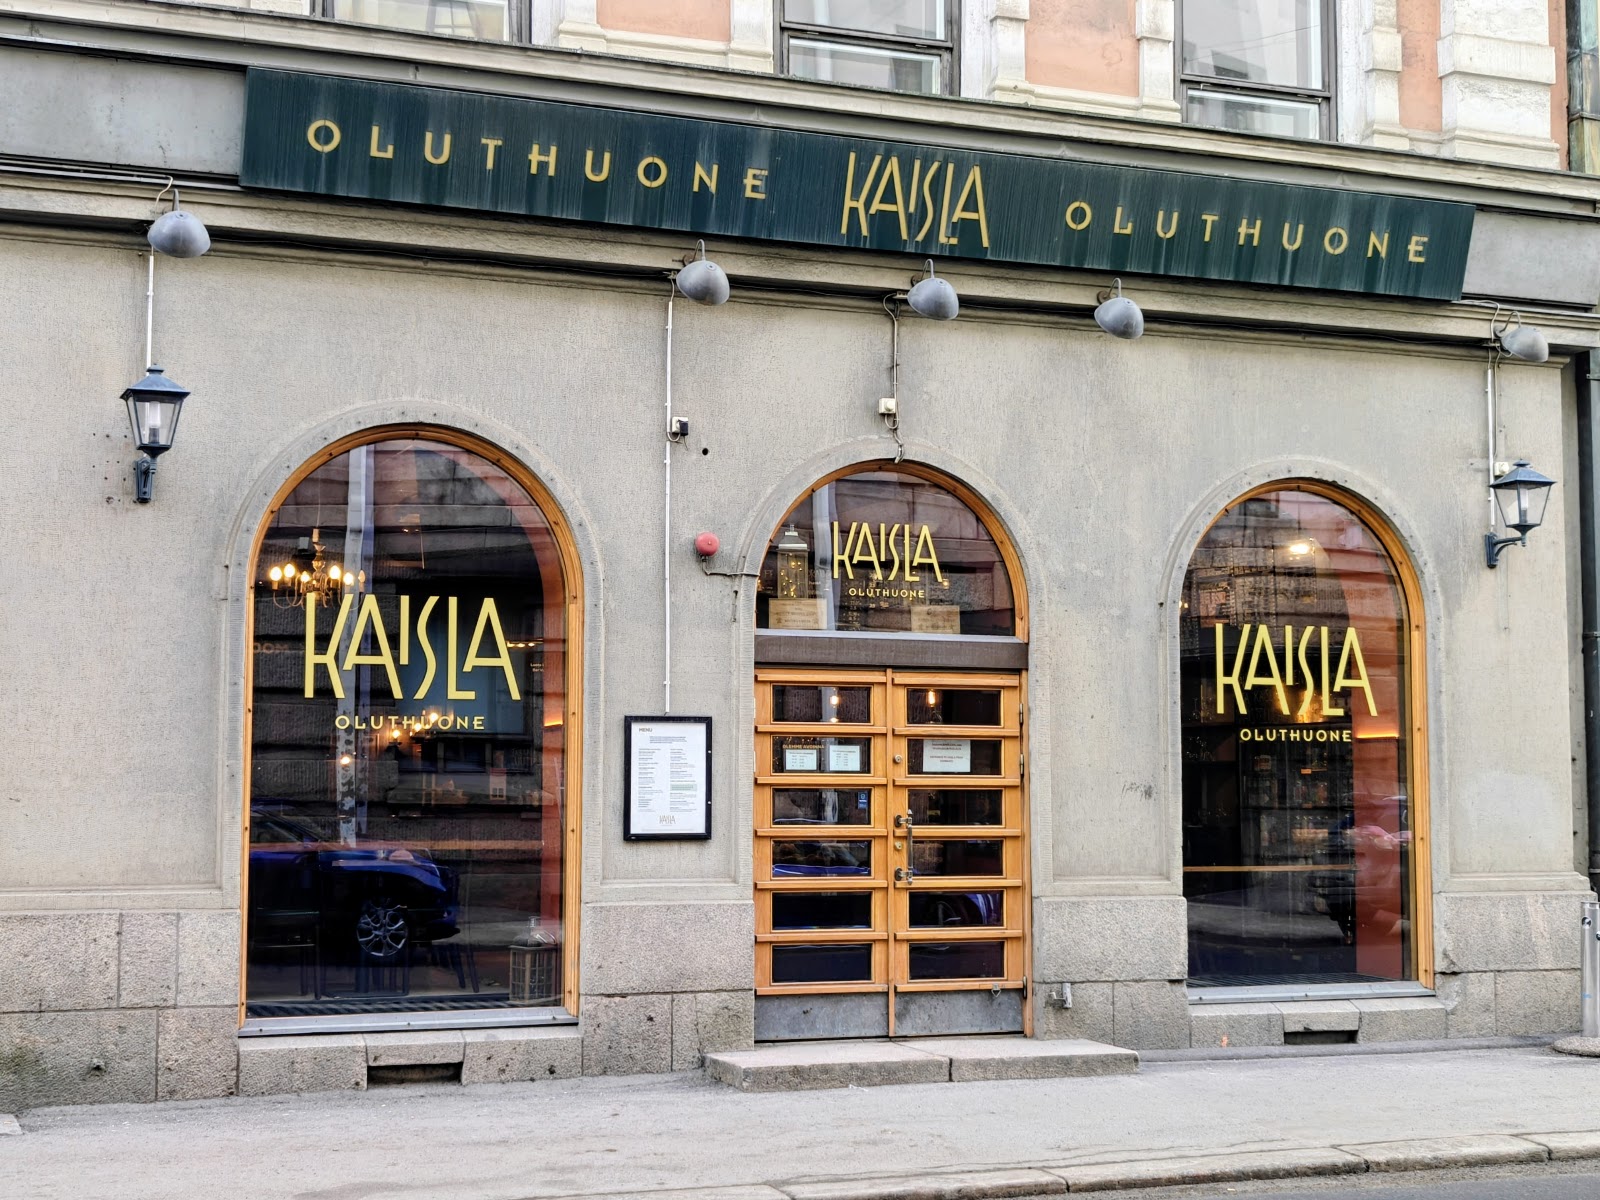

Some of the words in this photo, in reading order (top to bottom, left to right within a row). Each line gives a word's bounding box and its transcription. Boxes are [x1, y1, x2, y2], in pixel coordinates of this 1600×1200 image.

[306, 118, 769, 200] OLUTHUONE
[840, 151, 990, 248] KAISLA
[1065, 201, 1429, 263] OLUTHUONE
[833, 521, 943, 583] KAISLA
[848, 587, 925, 598] OLUTHUONE
[304, 592, 522, 701] KAISLA
[1215, 622, 1379, 717] KAISLA
[335, 714, 486, 730] OLUTHUONE
[1240, 728, 1352, 742] OLUTHUONE
